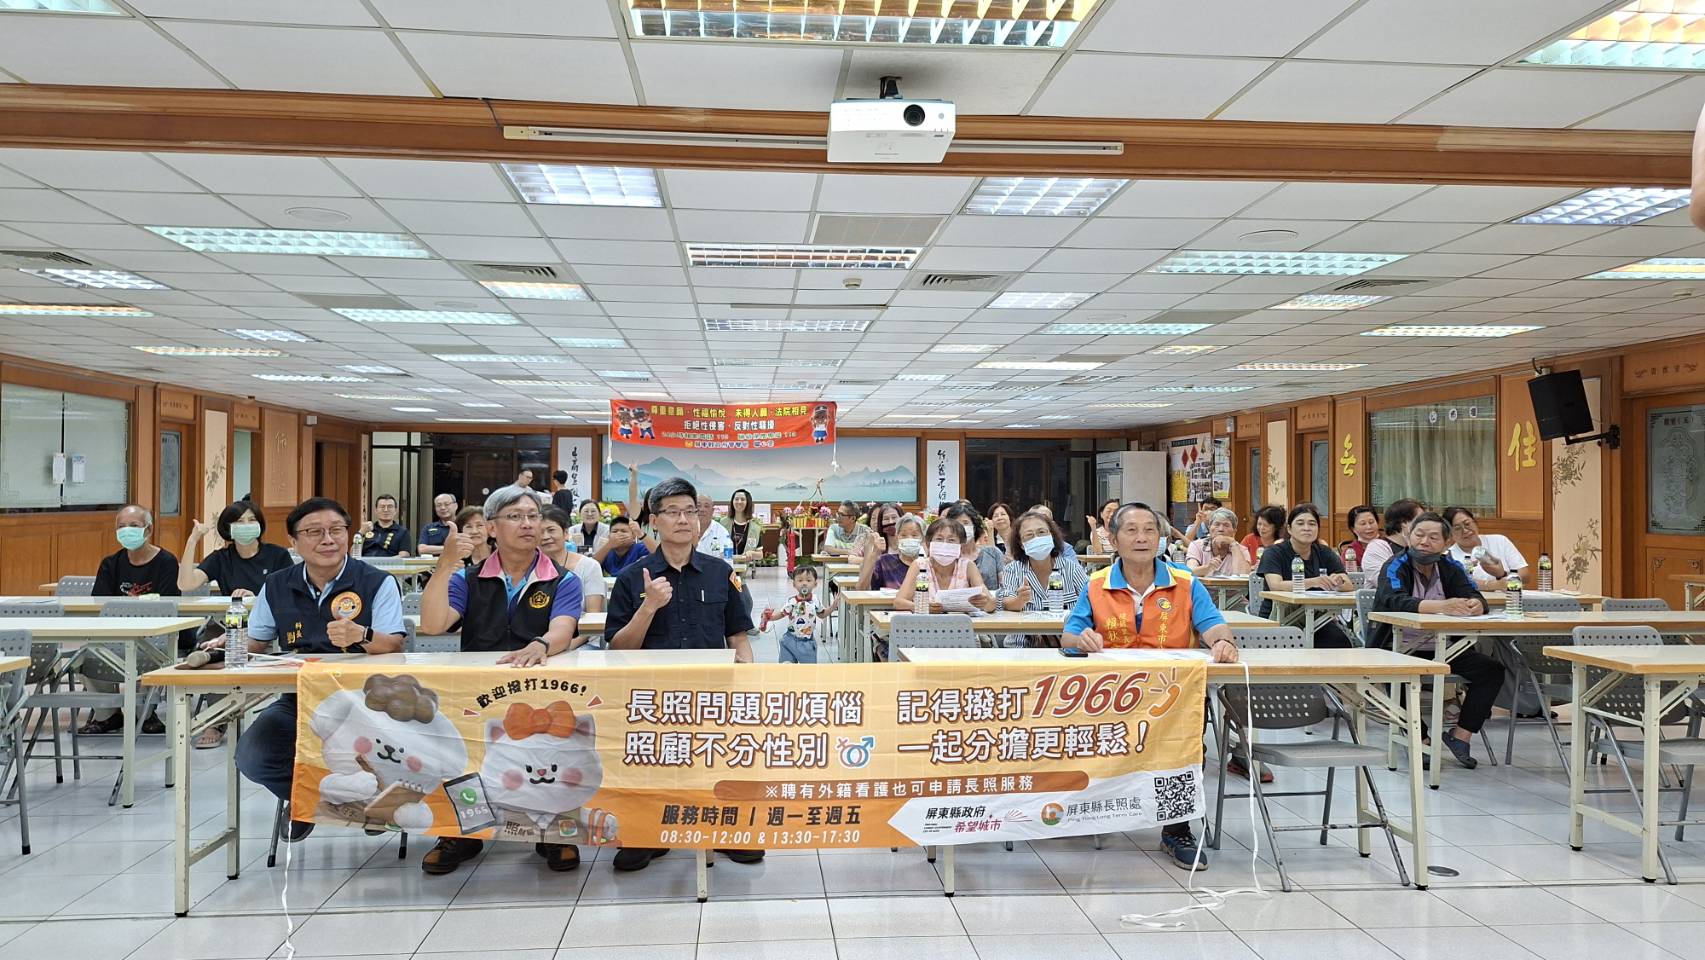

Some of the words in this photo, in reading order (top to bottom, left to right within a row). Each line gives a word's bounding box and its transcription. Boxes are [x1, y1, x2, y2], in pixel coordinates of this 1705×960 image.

[475, 677, 588, 709] 歡迎撥打1966!
[625, 688, 864, 727] 長照問題別煩惱
[623, 731, 830, 770] 照顧不分性別
[897, 721, 1149, 765] 一起分擔更輕鬆!
[661, 805, 738, 826] 服務時間
[767, 805, 861, 826] 週一至週五
[925, 805, 986, 820] 屏東縣政府
[1066, 797, 1143, 817] 屏東縣長照處
[954, 819, 1003, 834] 希望城市
[660, 829, 752, 845] 08:30-12:00
[758, 831, 767, 845] &
[773, 830, 861, 845] 13:30-17:30
